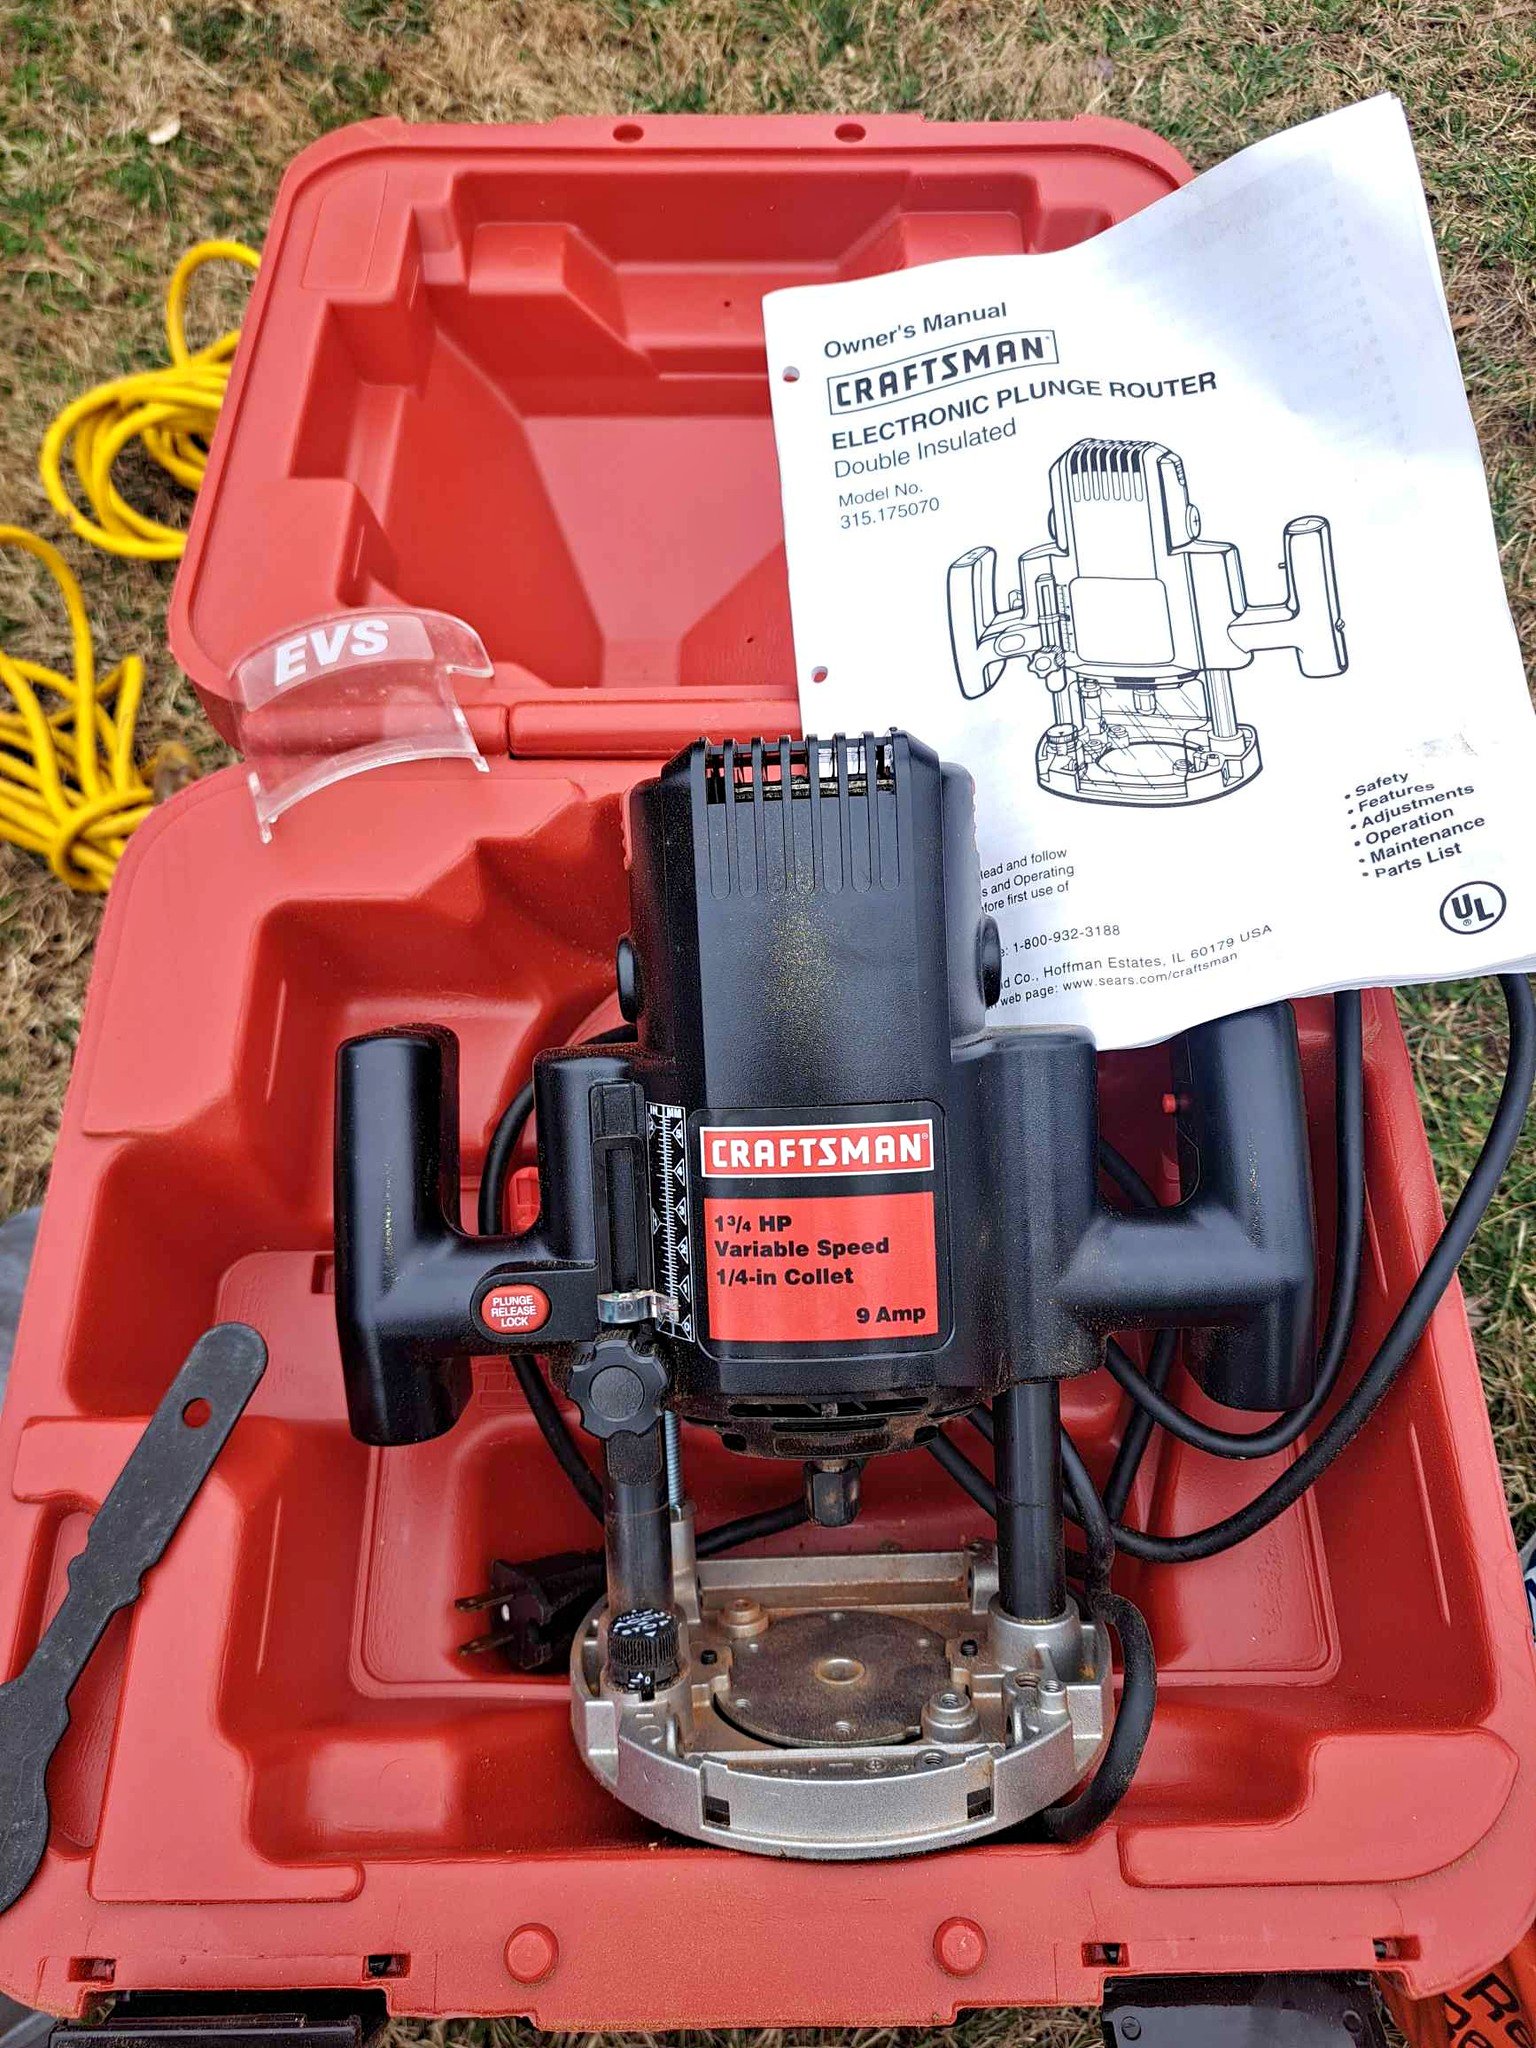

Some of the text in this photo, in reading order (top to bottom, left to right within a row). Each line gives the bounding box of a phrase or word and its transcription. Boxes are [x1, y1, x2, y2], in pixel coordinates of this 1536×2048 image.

[824, 302, 1007, 358] Owner's Manual
[836, 337, 1044, 407] CRAFTSMAN
[832, 371, 1217, 450] ELECTRONIC PLUNGE ROUTER
[834, 417, 1017, 478] Double Insulated
[839, 482, 923, 508] Model No.
[840, 497, 940, 530] 315.175070
[274, 619, 389, 687] EVS
[1355, 773, 1409, 797] Safety
[1358, 783, 1435, 812] Features
[1362, 785, 1475, 829] Adjustments
[1366, 808, 1454, 845] Operation
[1370, 817, 1485, 863] Maintenance
[1006, 855, 1028, 871] and
[1031, 849, 1067, 864] follow
[1375, 842, 1463, 878] Parts List
[991, 878, 1011, 895] and
[1013, 865, 1075, 887] Operating
[1007, 891, 1028, 905] first
[1031, 886, 1053, 899] use
[1057, 880, 1069, 892] of
[1451, 893, 1495, 922] UL
[1013, 925, 1120, 953] 1-800-932-3188
[1044, 959, 1102, 978] Hoffman
[1108, 956, 1166, 969] Estates,
[1172, 953, 1186, 964] IL
[1190, 937, 1235, 960] 60179
[1239, 924, 1273, 943] USA
[1000, 992, 1022, 1007] web
[1025, 984, 1058, 1003] page:
[1062, 951, 1239, 992] www.sears.com/craftsman
[711, 1133, 922, 1168] CRAFTSMAN
[759, 1215, 792, 1232] HP
[714, 1237, 890, 1259] Variable Speed
[716, 1268, 854, 1286] 1/4-in Collet
[491, 1305, 538, 1318] RELEASE
[492, 1295, 534, 1306] PLUNGE
[501, 1316, 529, 1328] LOCK
[856, 1306, 926, 1325] 9 Amp
